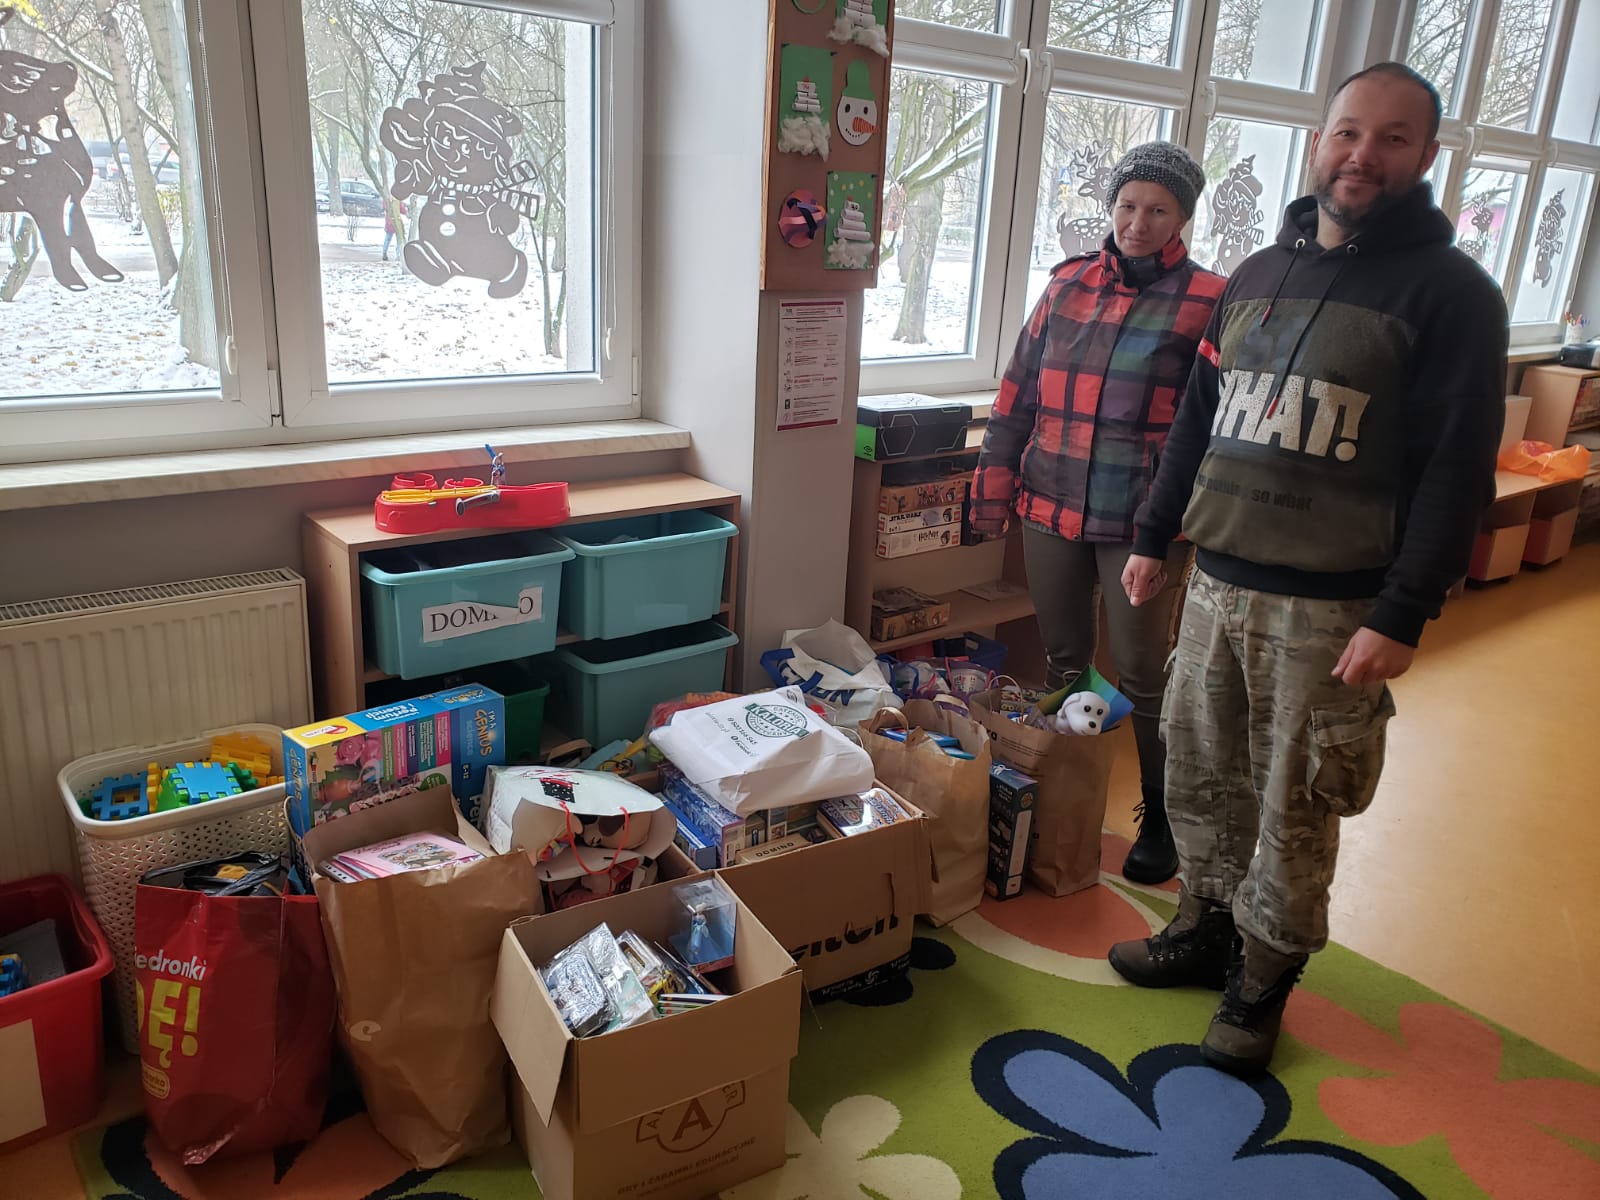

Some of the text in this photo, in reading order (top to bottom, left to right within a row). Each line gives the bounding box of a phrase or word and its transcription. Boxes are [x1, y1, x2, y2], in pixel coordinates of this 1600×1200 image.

[889, 514, 905, 522] STAR
[431, 596, 534, 633] DOMO
[475, 708, 493, 757] GENIUS
[750, 706, 801, 735] KALORIA
[755, 841, 795, 858] DOMINO
